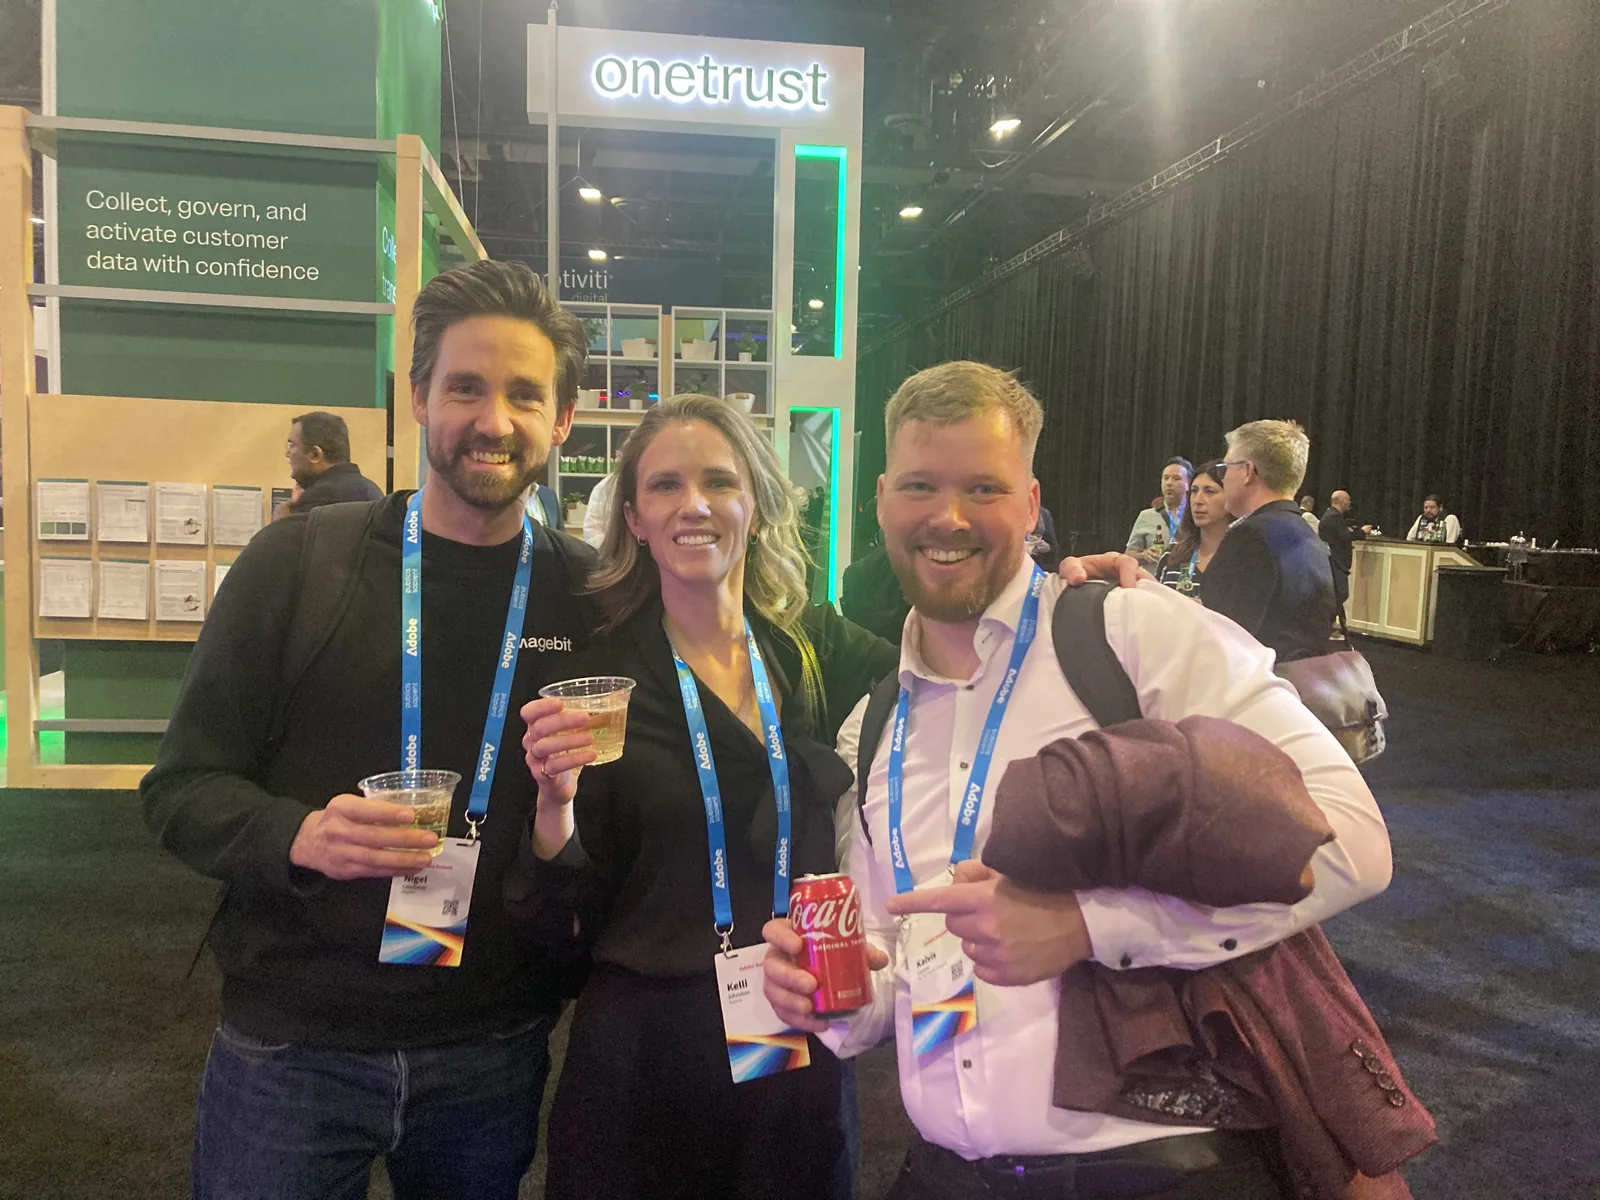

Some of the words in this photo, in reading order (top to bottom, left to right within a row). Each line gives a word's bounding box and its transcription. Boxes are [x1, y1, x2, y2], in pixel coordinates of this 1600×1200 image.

[594, 55, 828, 107] onetrust
[85, 189, 172, 215] Collect,
[177, 198, 260, 221] govern,
[266, 202, 307, 222] and
[85, 221, 177, 244] activate
[182, 227, 289, 250] customer
[86, 250, 138, 272] data
[143, 254, 190, 275] with
[195, 258, 320, 281] confidence
[407, 510, 418, 544] Adobe
[406, 618, 418, 657] Adobe
[501, 631, 517, 669] Adobe
[996, 668, 1017, 704] Adobe
[696, 732, 711, 770] Adobe
[768, 724, 783, 760] Adobe
[478, 742, 496, 782] Adobe
[961, 782, 981, 826] Adobe
[778, 837, 788, 878] Adobe
[892, 828, 904, 869] Adobe
[713, 848, 725, 889] Adobe
[727, 979, 748, 991] Kelli
